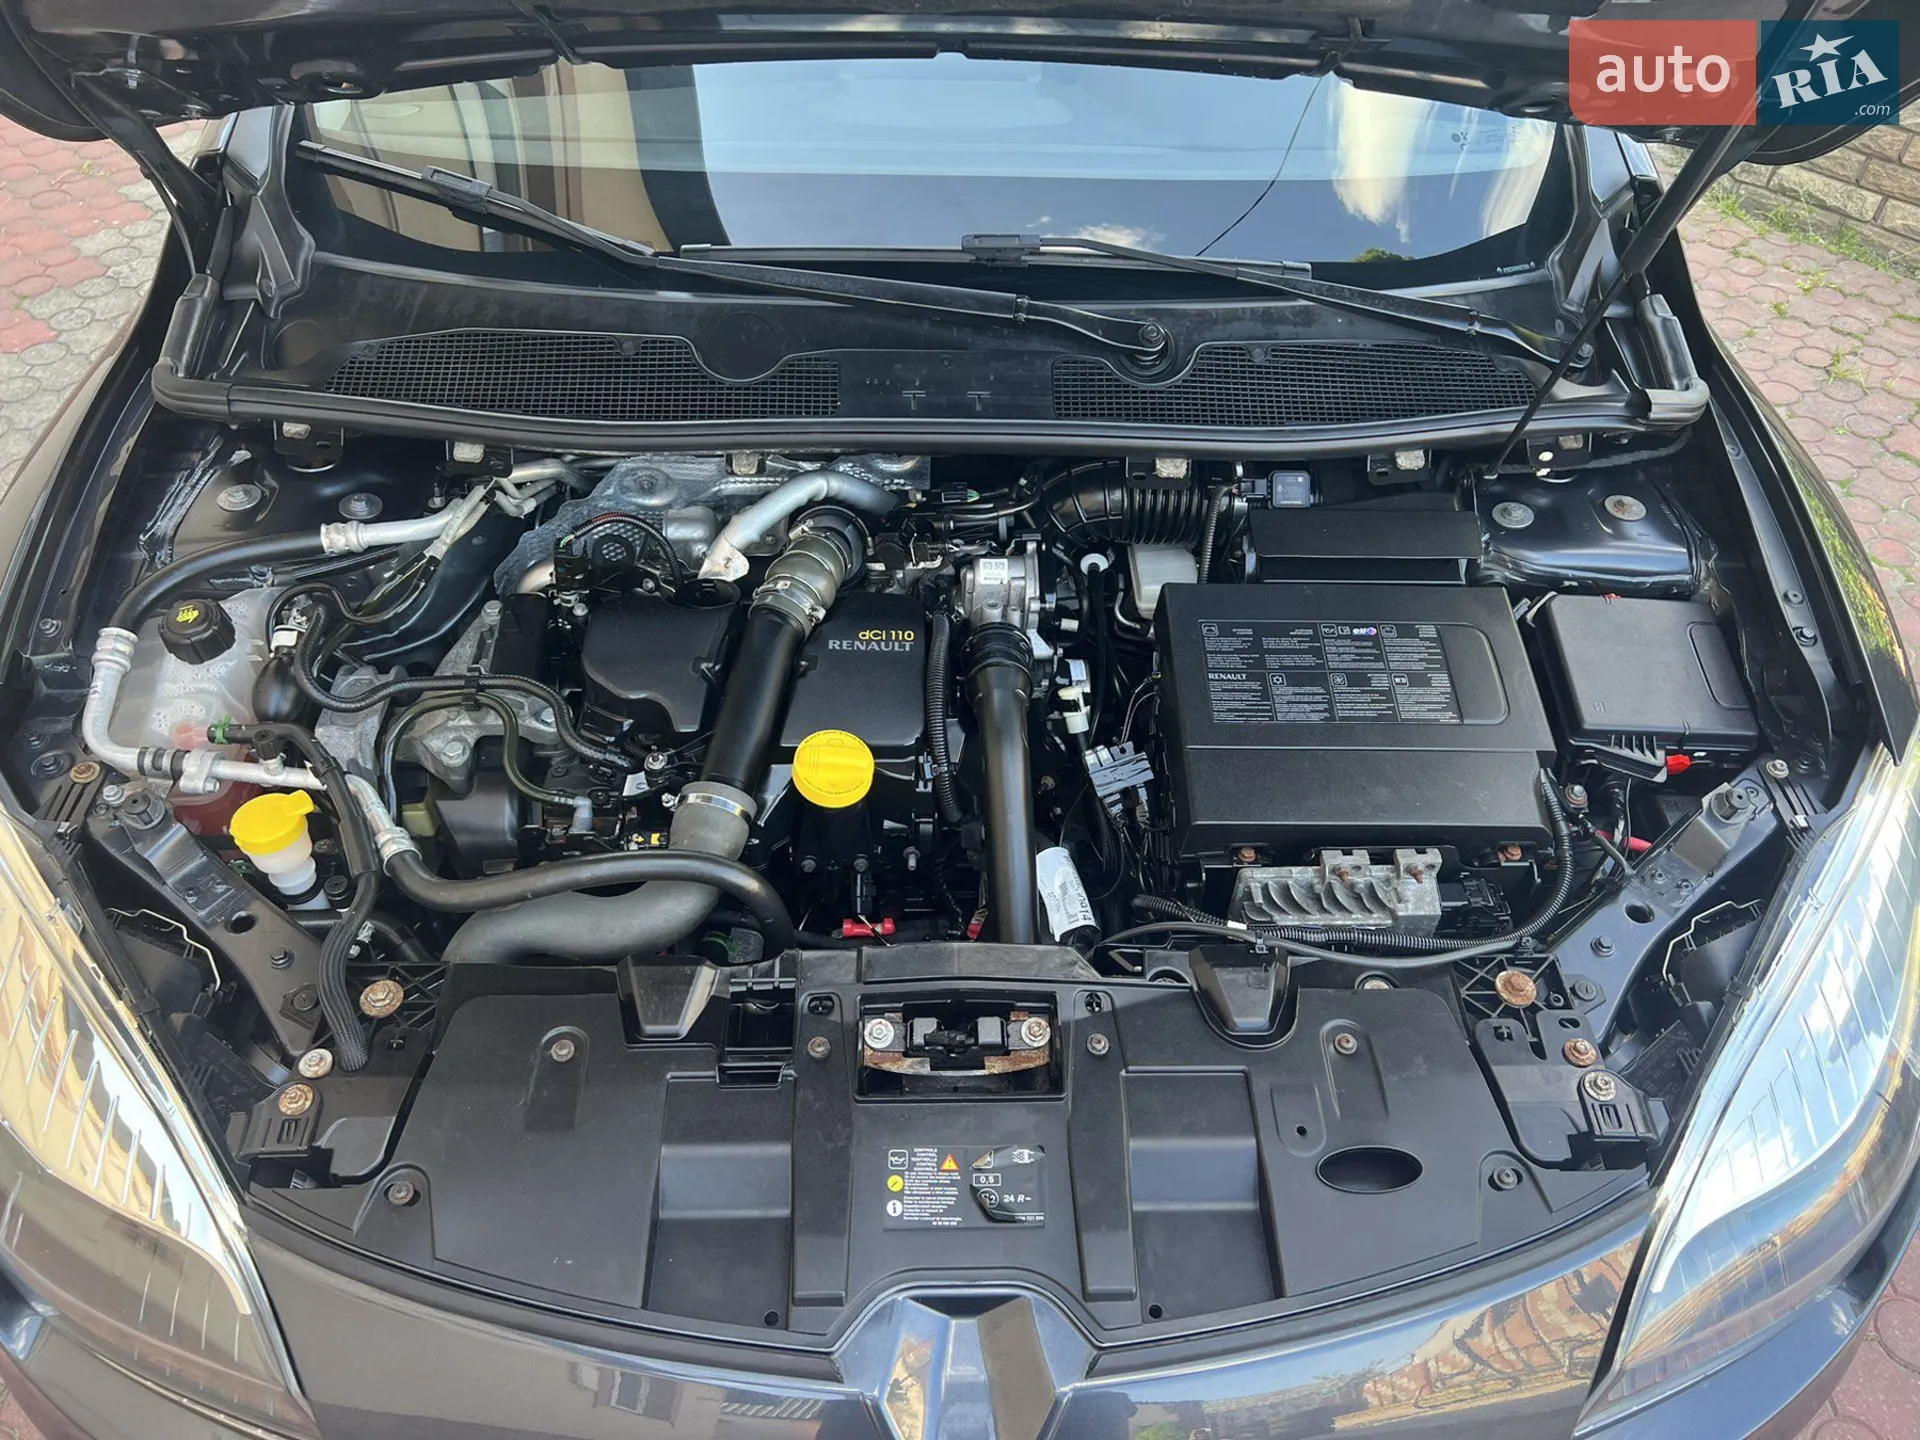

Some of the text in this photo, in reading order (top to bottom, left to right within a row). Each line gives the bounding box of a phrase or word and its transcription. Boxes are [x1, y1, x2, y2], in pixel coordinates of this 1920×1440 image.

[890, 630, 915, 641] 110
[828, 640, 914, 651] RENAULT
[1208, 672, 1247, 680] RENAULT
[1003, 1194, 1015, 1203] 24
